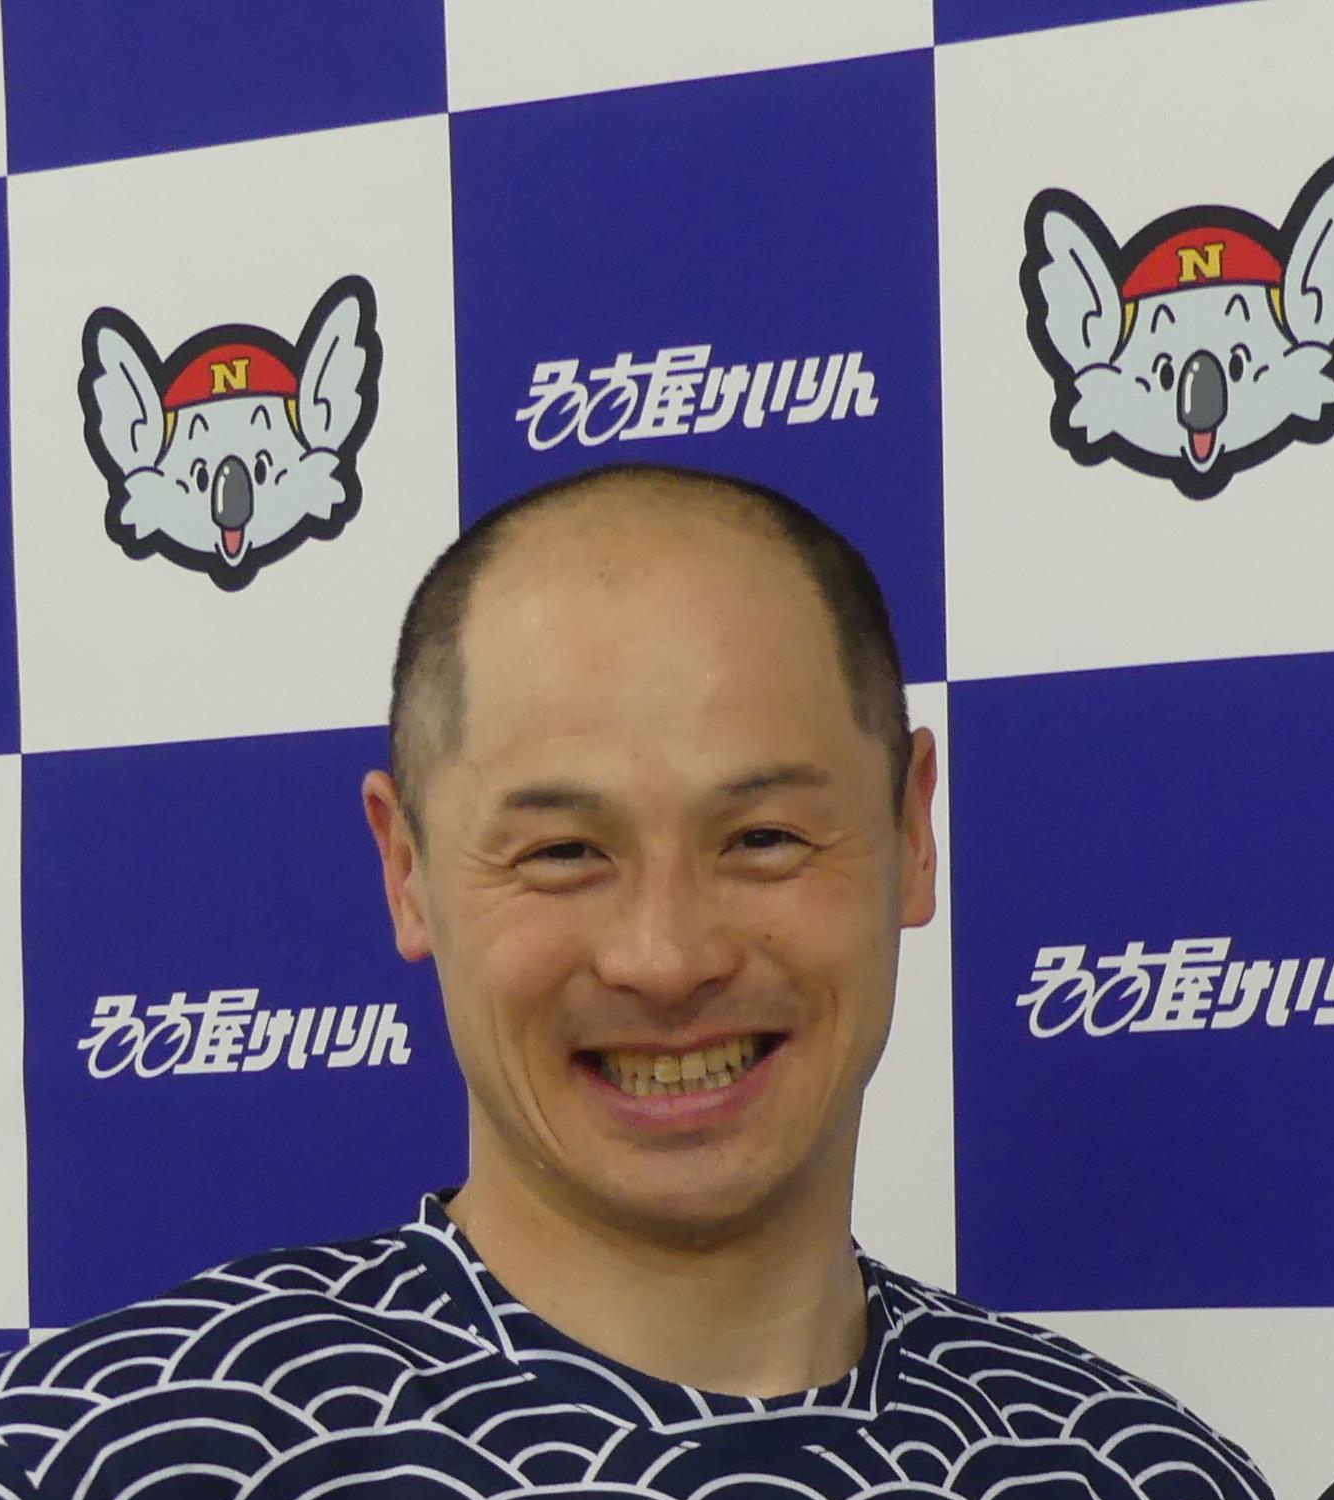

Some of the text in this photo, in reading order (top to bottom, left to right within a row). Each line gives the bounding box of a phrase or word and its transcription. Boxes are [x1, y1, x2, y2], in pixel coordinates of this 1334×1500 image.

[1178, 244, 1225, 282] N
[210, 359, 249, 393] N
[516, 345, 878, 450] 名古屋けいりん
[77, 989, 411, 1078] 名古屋けいりん
